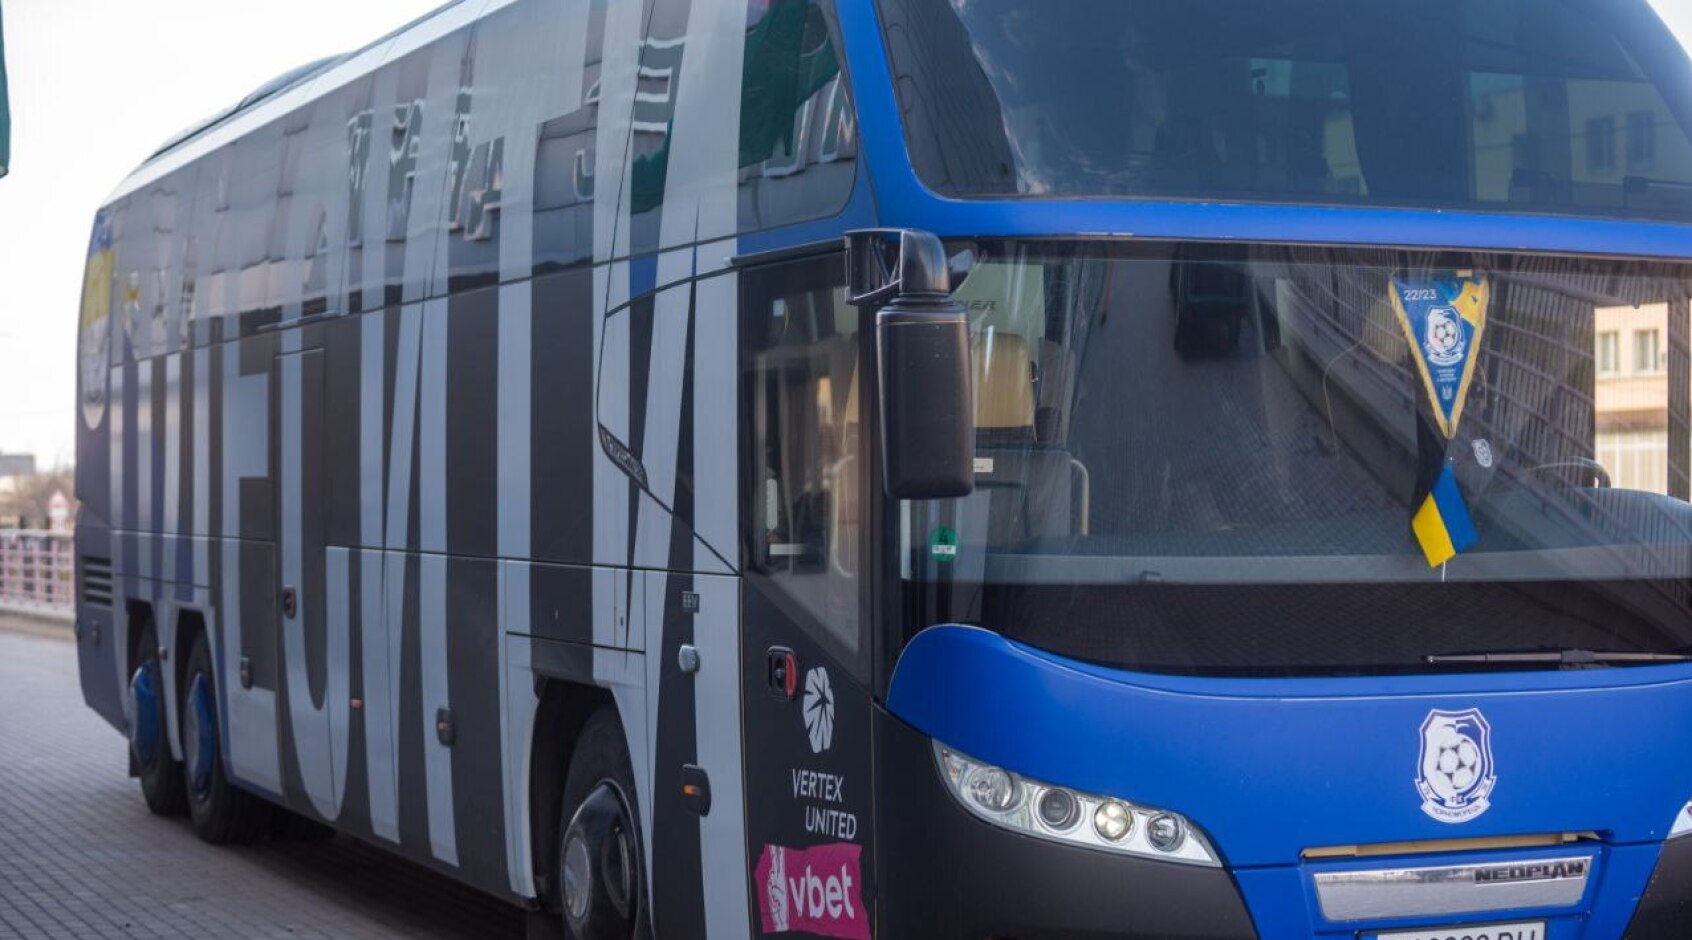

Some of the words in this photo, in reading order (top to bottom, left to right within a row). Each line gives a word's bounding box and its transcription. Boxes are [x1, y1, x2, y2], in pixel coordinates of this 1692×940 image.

[792, 768, 844, 803] VERTEX
[805, 806, 857, 840] UNITED
[1475, 860, 1584, 882] NEOPLAN
[789, 863, 855, 920] vbet
